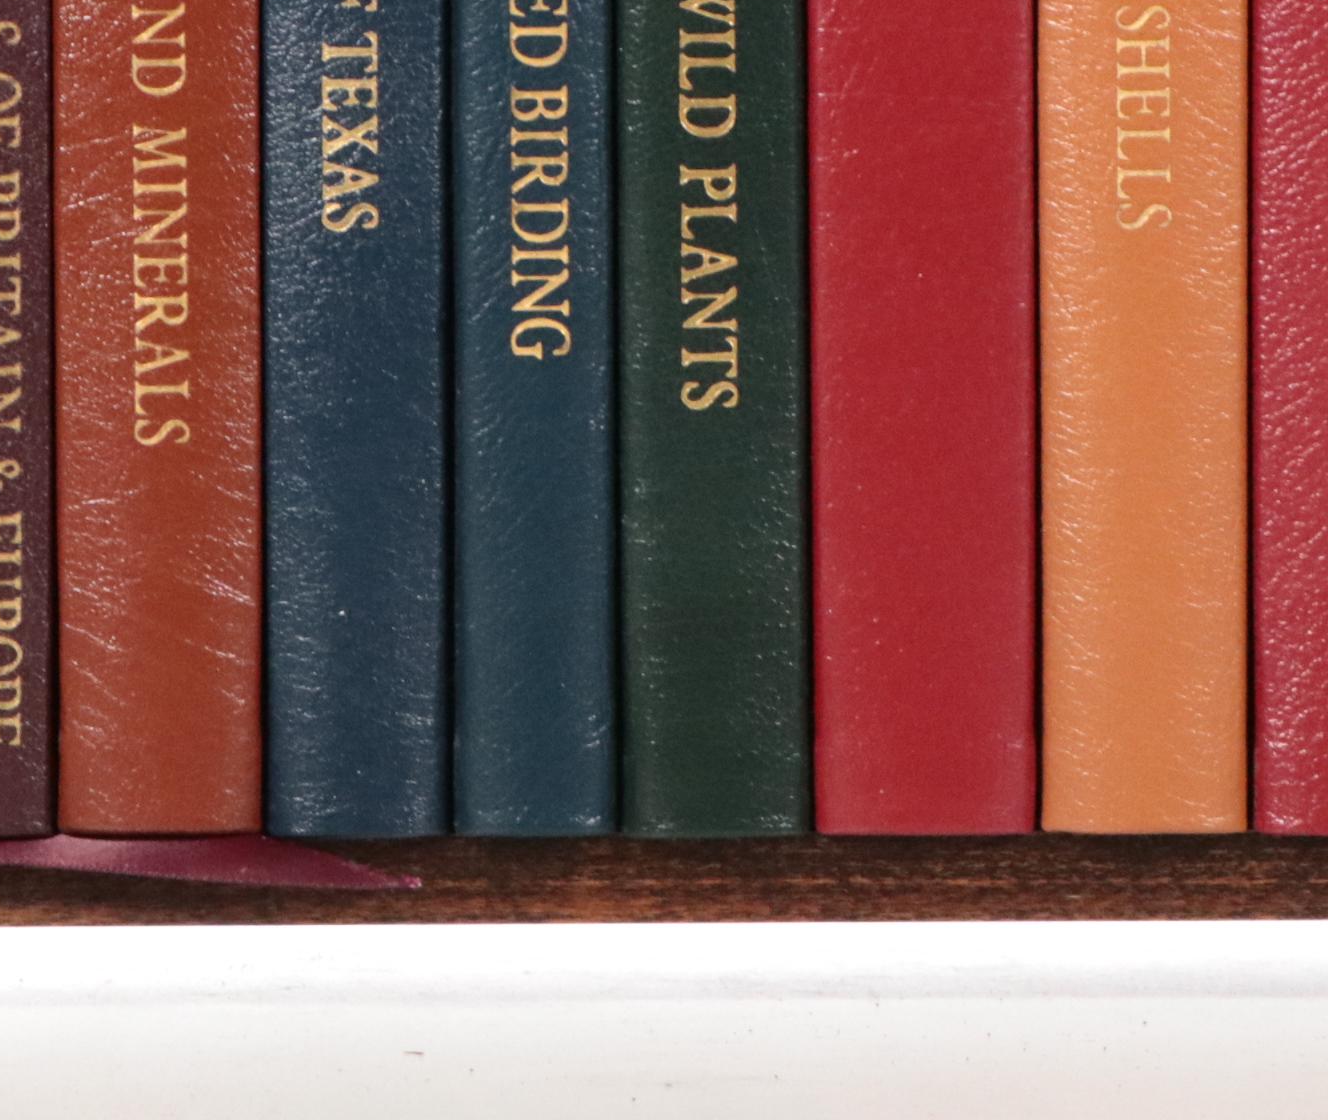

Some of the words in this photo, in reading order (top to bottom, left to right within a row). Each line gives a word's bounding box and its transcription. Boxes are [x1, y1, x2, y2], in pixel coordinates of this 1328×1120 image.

[320, 32, 379, 233] TEXAS
[509, 84, 572, 362] BIRDING
[1115, 5, 1172, 232] SHELLS
[132, 124, 191, 448] MINERALS
[679, 163, 740, 413] PLANTS
